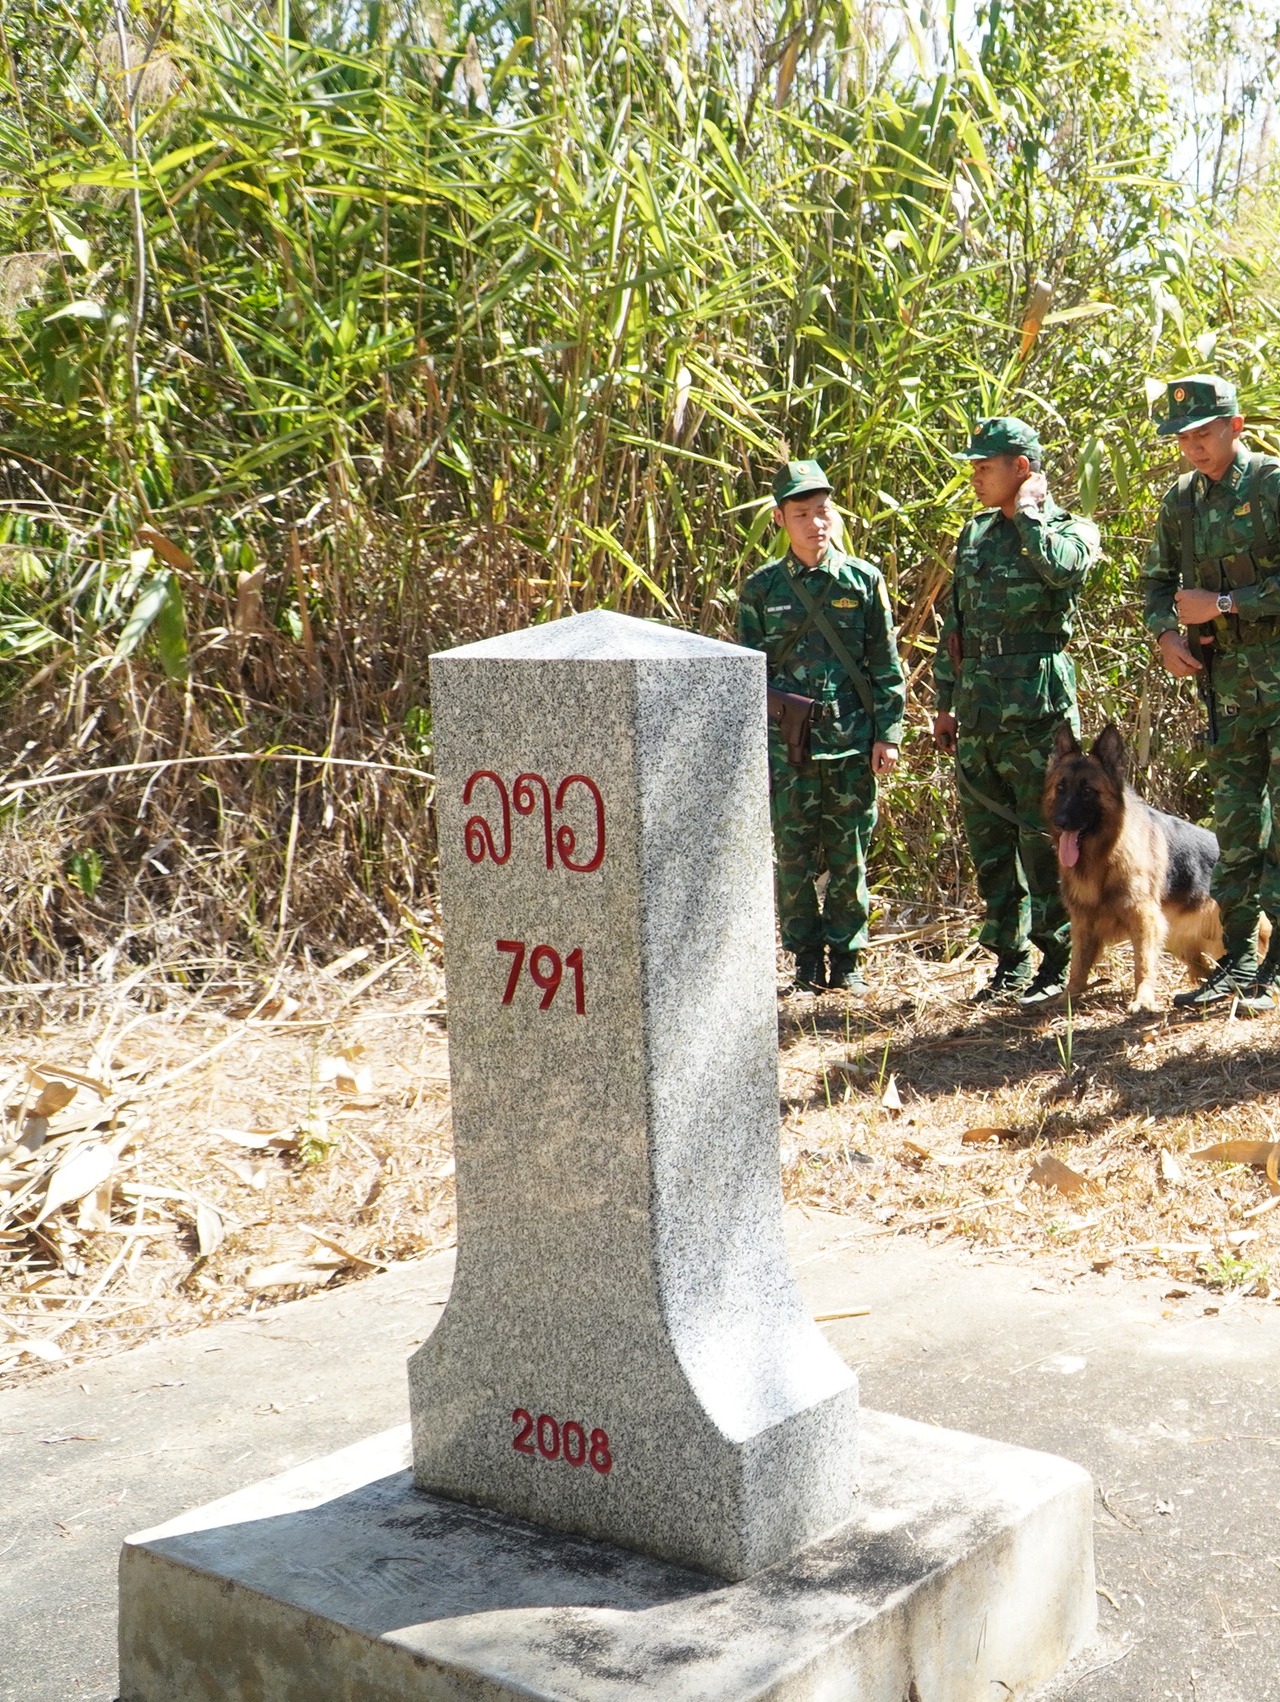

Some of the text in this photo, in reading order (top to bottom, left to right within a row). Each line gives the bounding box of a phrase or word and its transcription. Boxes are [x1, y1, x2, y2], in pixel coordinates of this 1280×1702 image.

[463, 771, 606, 873] ລາວ
[496, 940, 585, 1015] 791
[511, 1408, 612, 1474] 2008
